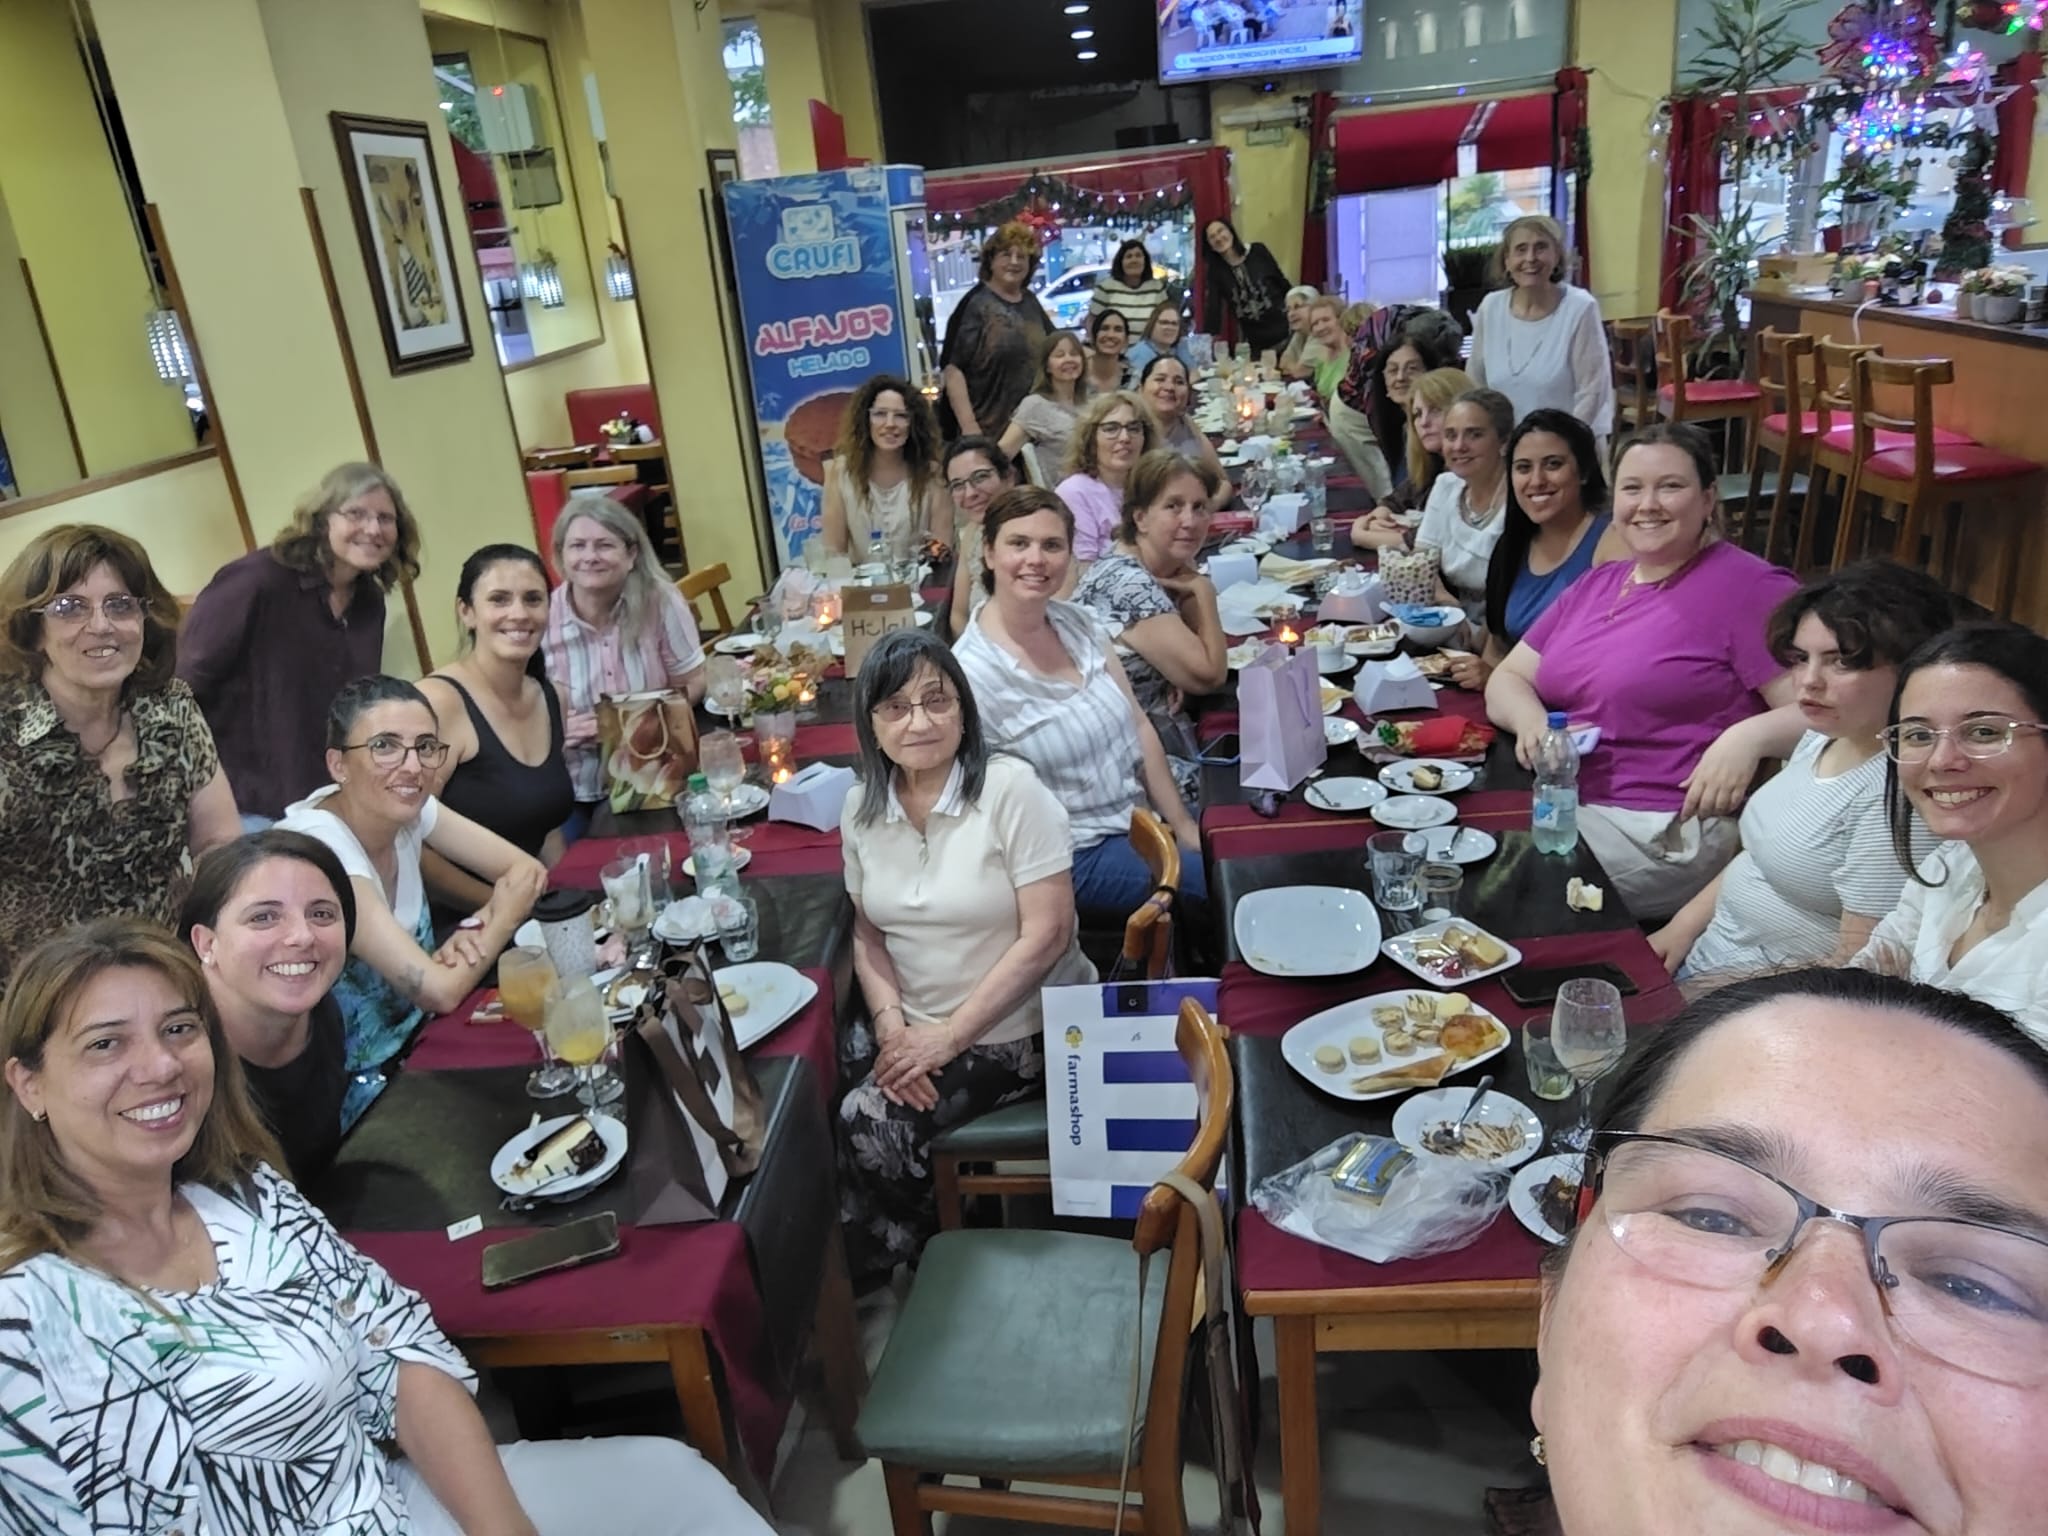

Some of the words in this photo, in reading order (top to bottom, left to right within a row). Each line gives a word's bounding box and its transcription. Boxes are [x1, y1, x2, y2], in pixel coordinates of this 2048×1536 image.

[771, 241, 857, 274] CRUFI
[757, 305, 891, 354] ALFAJOR
[789, 348, 869, 377] HELADO
[1066, 1054, 1085, 1147] farmashop
